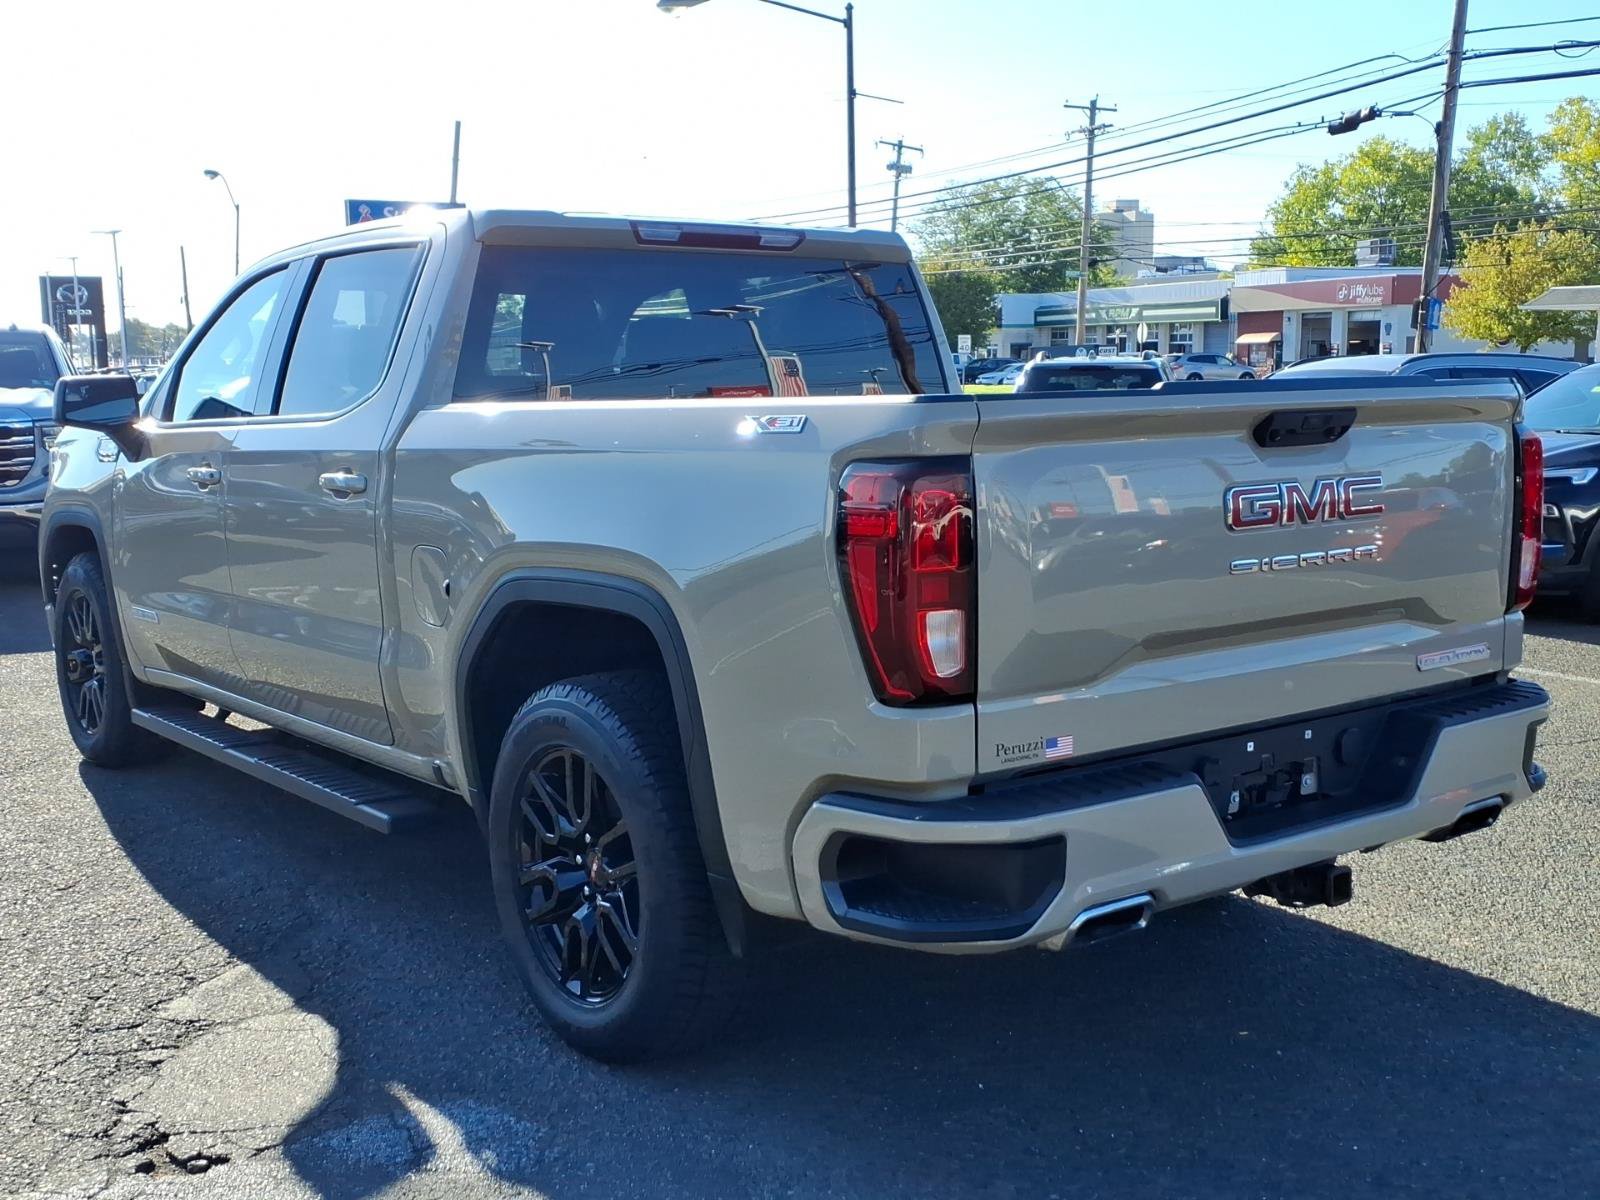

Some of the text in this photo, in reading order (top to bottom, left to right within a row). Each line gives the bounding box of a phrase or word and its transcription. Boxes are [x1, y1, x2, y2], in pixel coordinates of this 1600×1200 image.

[1223, 475, 1385, 531] GMC
[1229, 545, 1379, 575] SIERRA
[995, 736, 1044, 757] Peruzzi
